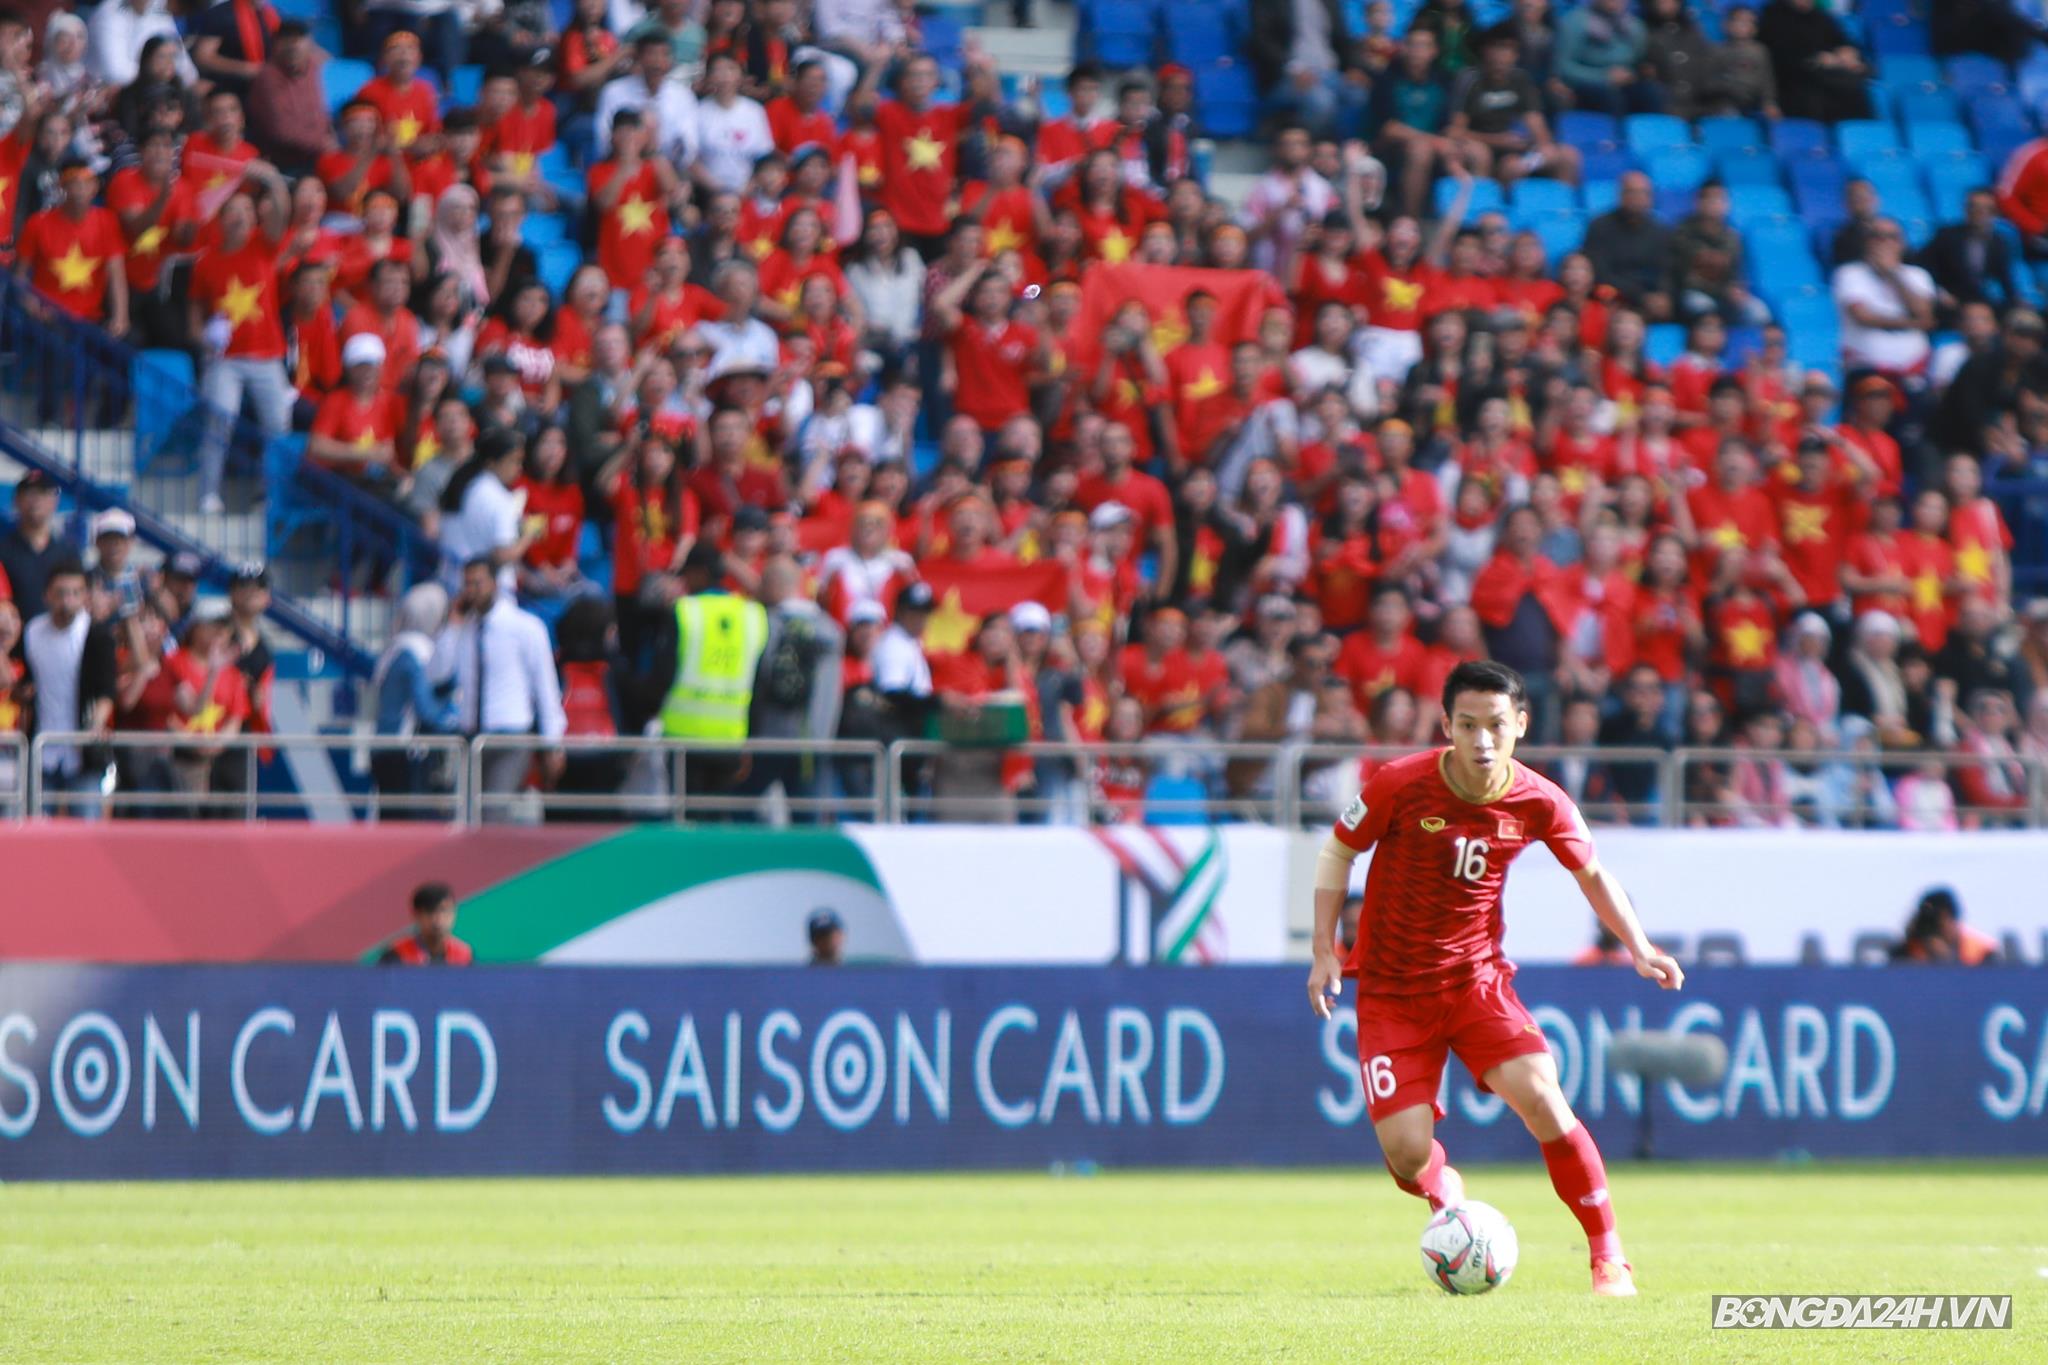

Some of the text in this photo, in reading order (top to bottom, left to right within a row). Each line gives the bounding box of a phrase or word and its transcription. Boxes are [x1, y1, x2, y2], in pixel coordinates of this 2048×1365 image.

[1453, 835, 1490, 881] 16
[231, 1006, 499, 1134] CARD
[603, 1004, 1226, 1132] SAISON CARD
[1362, 1054, 1397, 1105] 16
